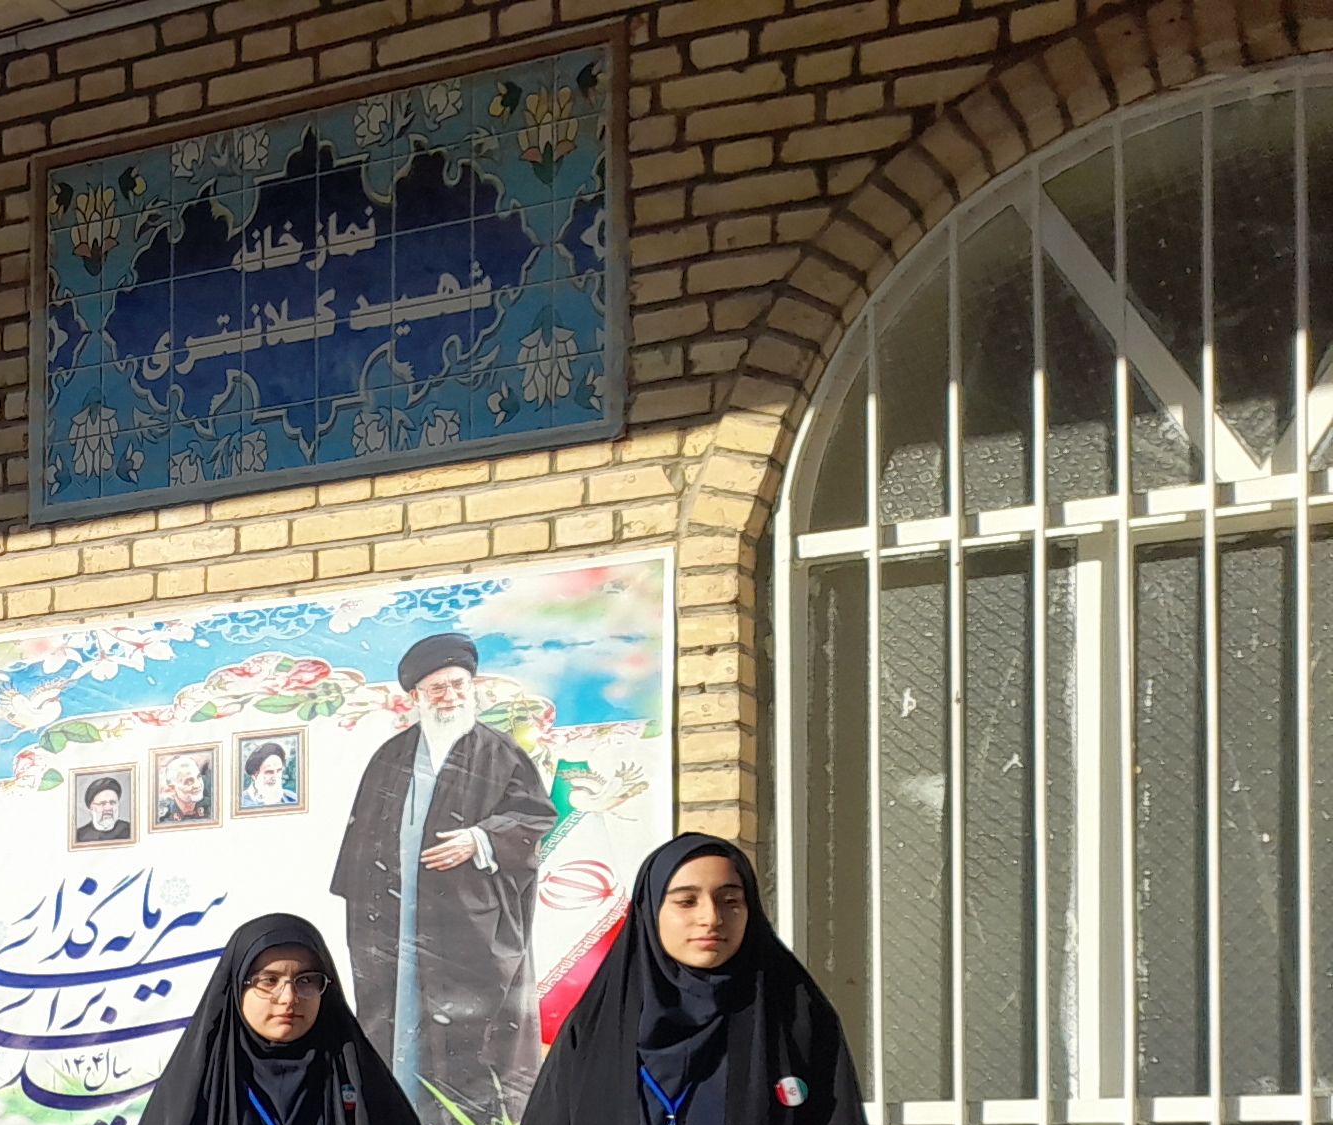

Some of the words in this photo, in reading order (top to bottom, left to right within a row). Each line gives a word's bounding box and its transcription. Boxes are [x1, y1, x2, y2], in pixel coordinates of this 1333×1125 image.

[349, 259, 492, 336] شهید
[143, 288, 336, 380] کلانتری
[63, 1053, 106, 1078] ۱۴۰۴
[83, 1049, 133, 1092] سال
